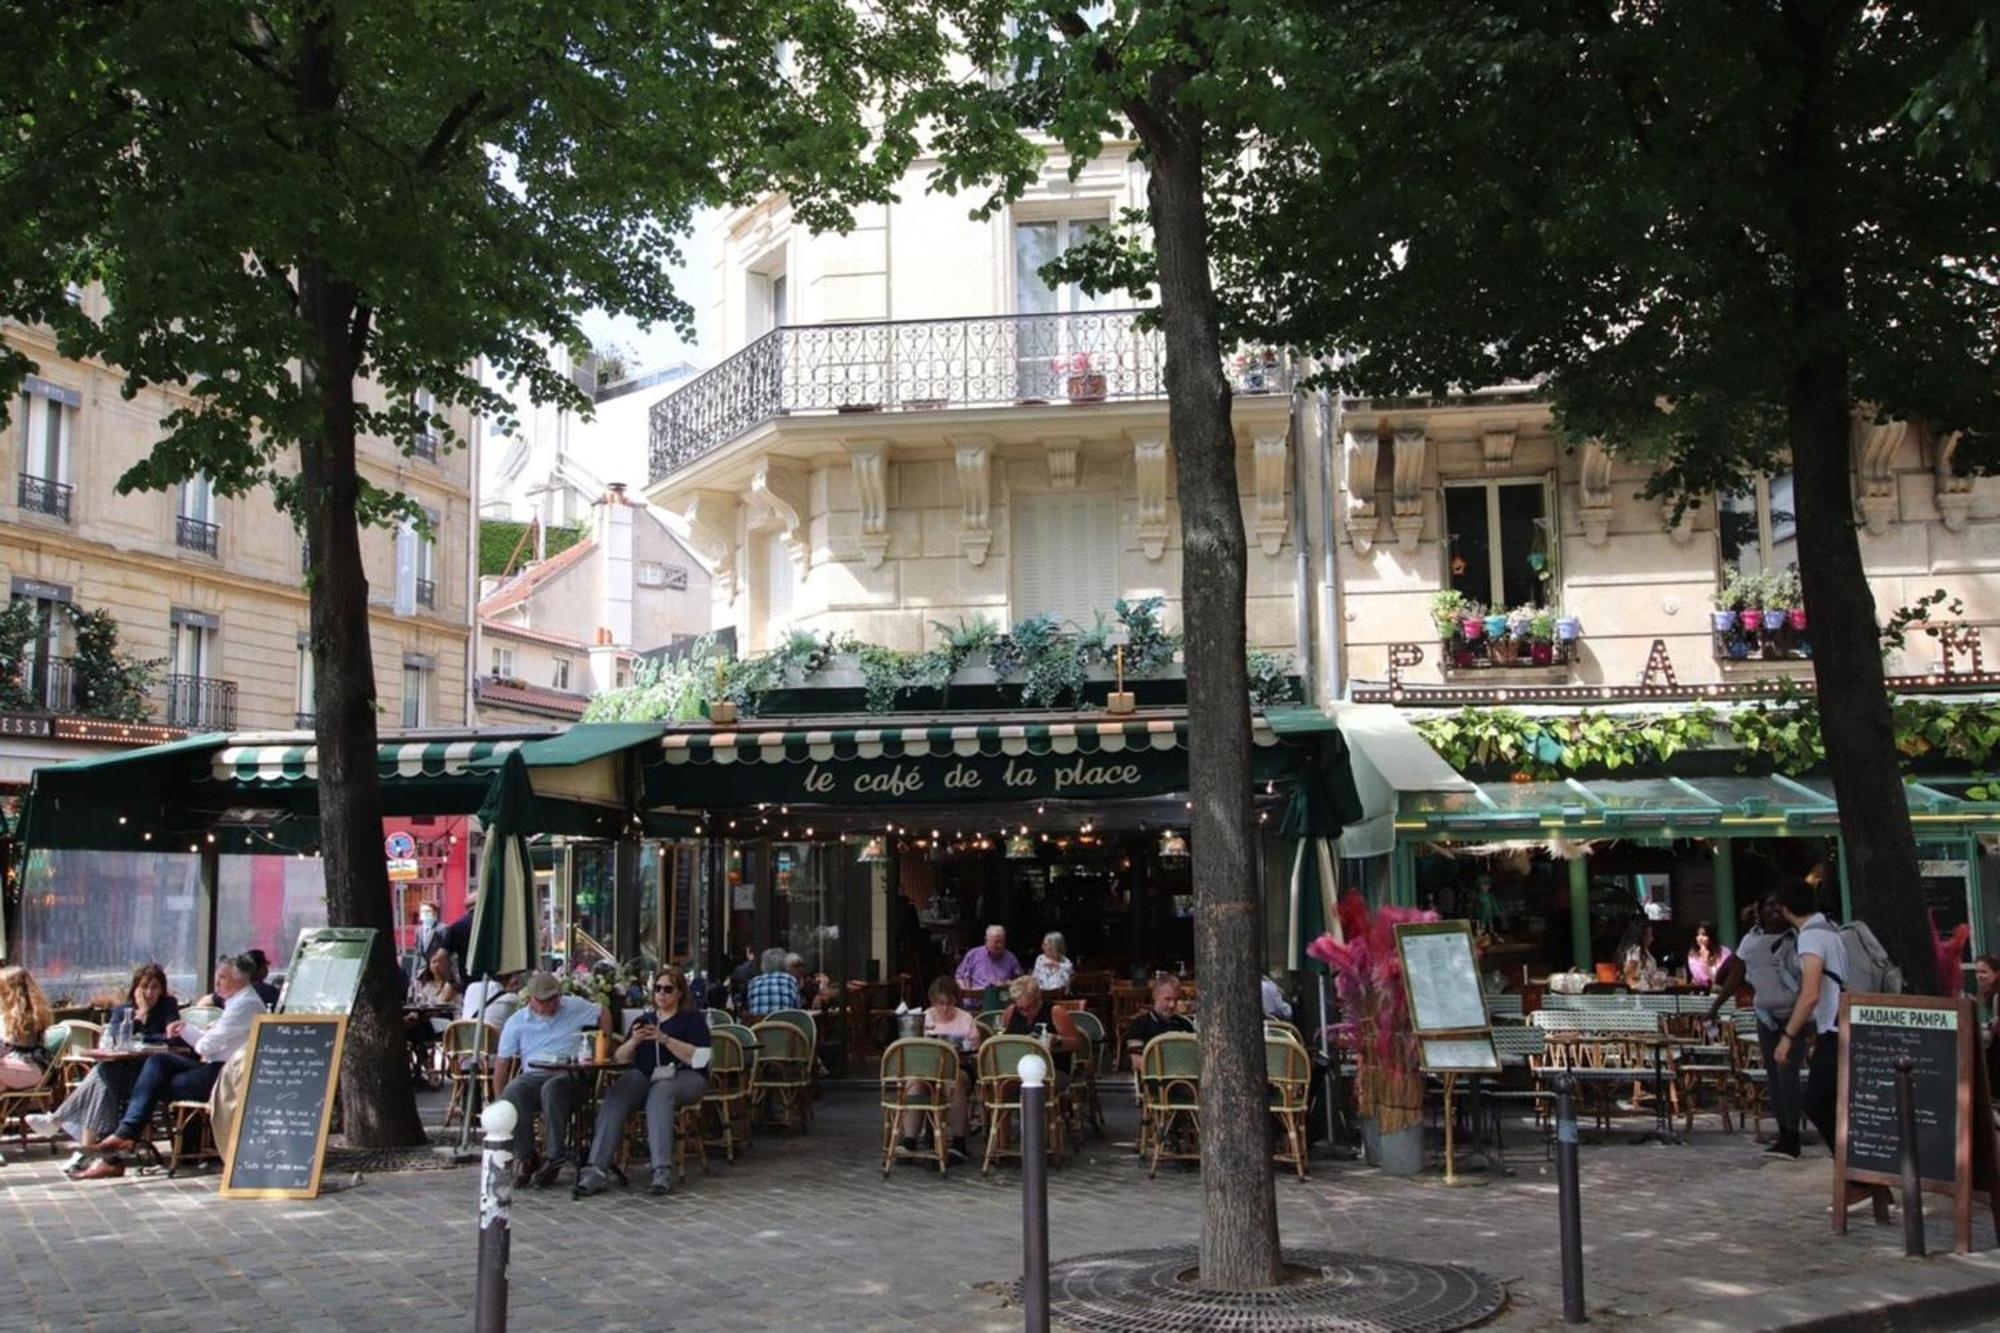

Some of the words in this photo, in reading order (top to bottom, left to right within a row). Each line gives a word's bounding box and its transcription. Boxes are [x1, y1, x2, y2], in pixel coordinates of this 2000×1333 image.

[2, 717, 50, 735] ESSA
[804, 764, 836, 792] le
[853, 765, 924, 796] café
[944, 763, 982, 788] de
[1002, 760, 1037, 786] la
[1055, 758, 1142, 791] place
[1859, 1009, 1907, 1025] MADAME
[1909, 1012, 1948, 1027] PAMPA
